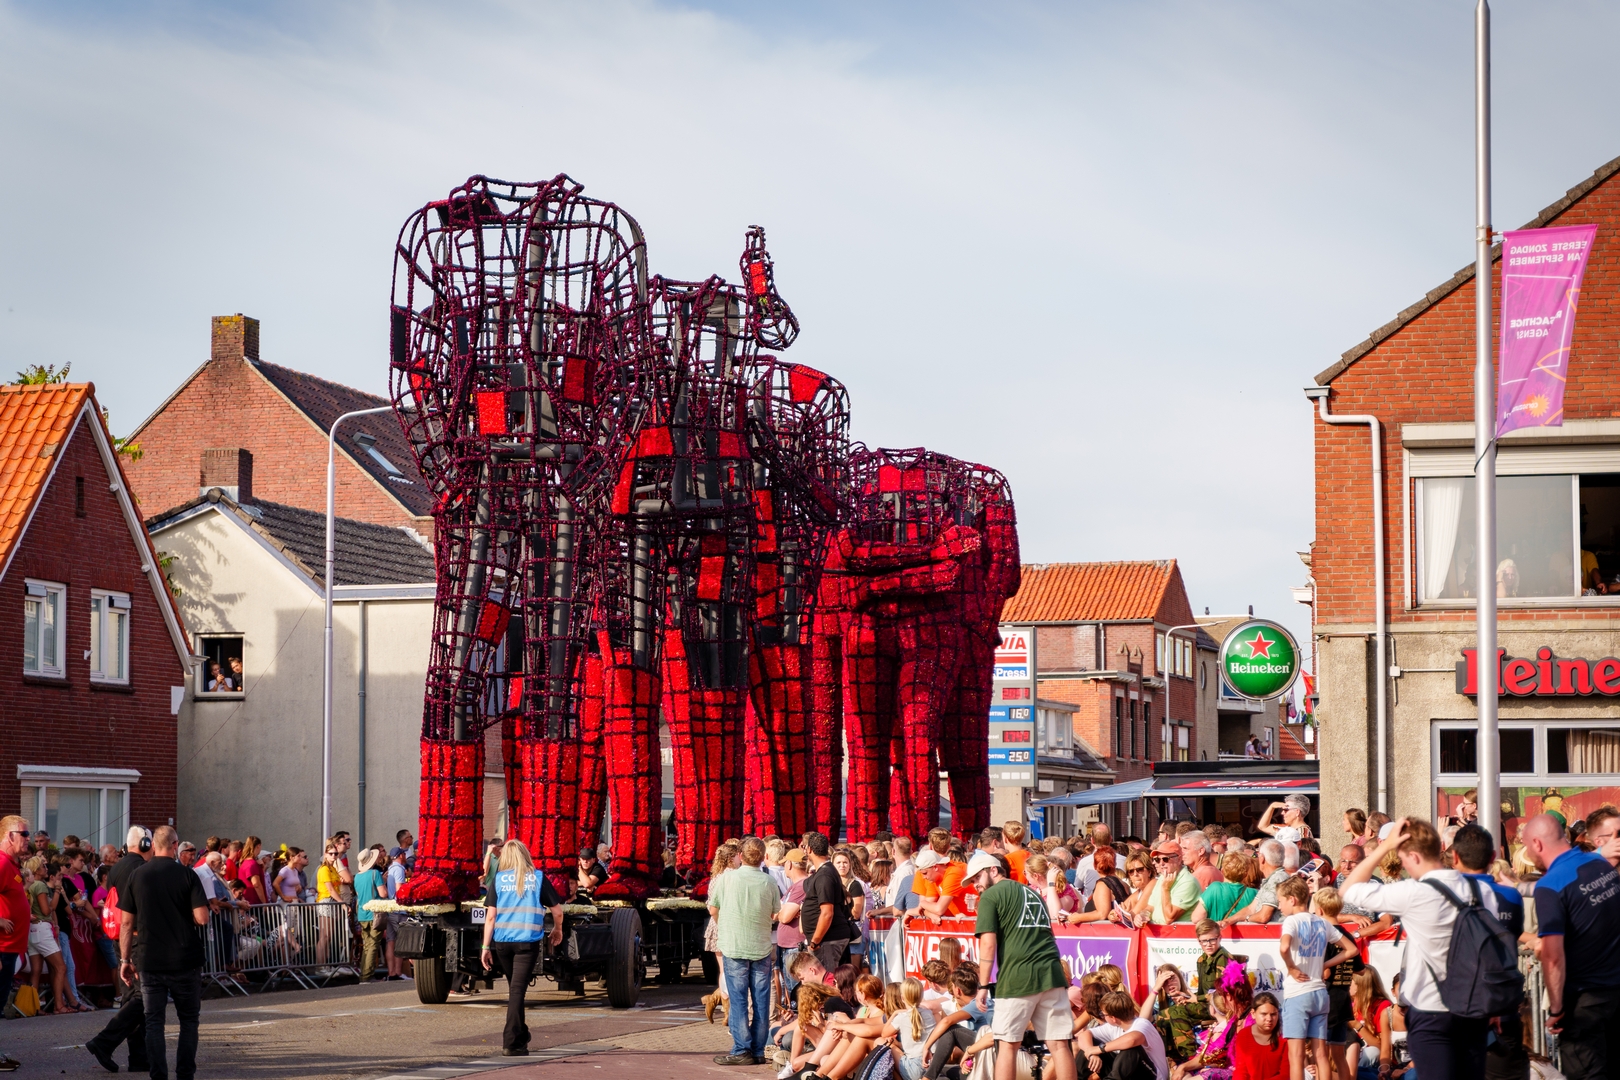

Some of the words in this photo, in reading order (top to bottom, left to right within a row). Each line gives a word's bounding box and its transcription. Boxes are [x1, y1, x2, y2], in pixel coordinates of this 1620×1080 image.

[995, 634, 1027, 649] VIA
[994, 667, 1026, 677] Press
[1230, 662, 1290, 674] Heineken
[501, 883, 536, 892] zunert
[1579, 868, 1618, 895] Scorpions
[473, 909, 485, 919] 09
[1060, 940, 1112, 980] ndert
